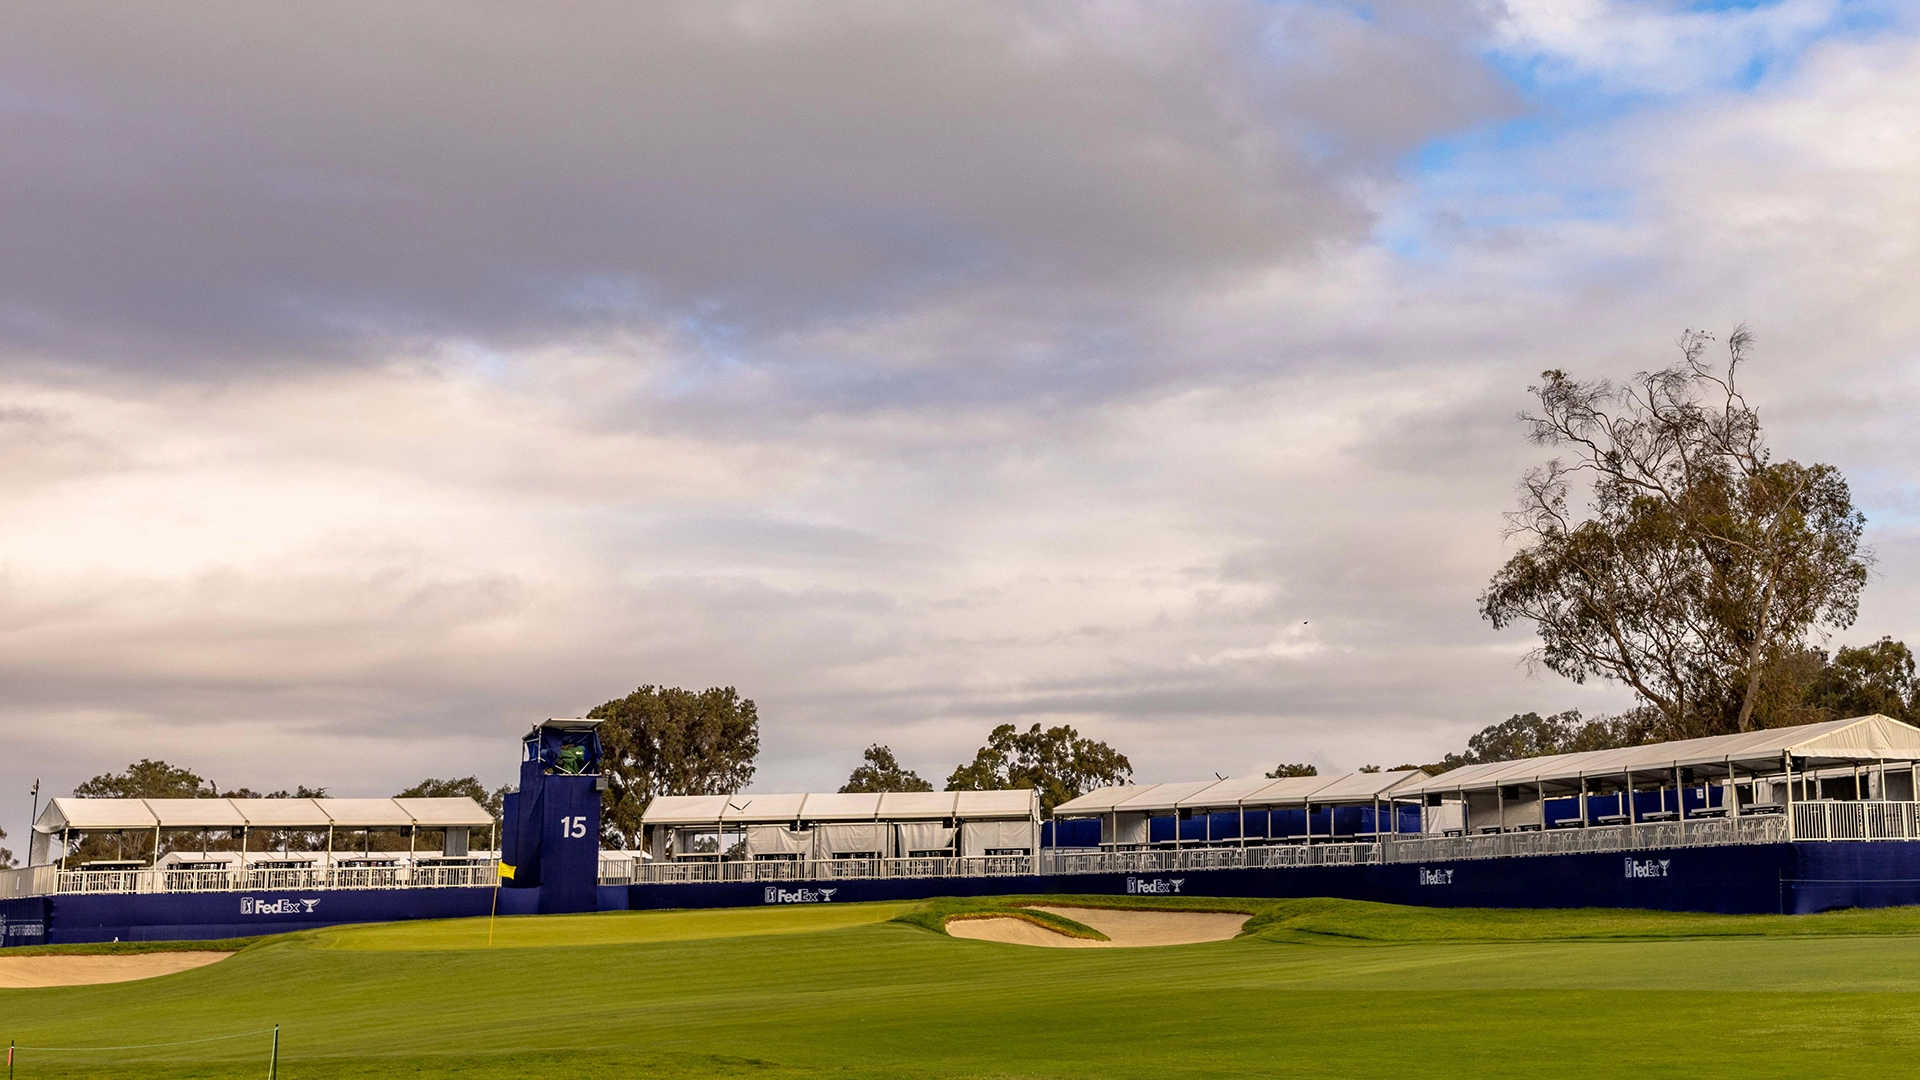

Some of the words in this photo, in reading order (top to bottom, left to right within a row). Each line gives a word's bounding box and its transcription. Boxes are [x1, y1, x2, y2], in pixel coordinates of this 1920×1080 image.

[561, 816, 587, 838] 15
[1633, 860, 1660, 878] FedEx
[1426, 869, 1446, 885] FedEx
[1137, 879, 1170, 893] FedEx
[777, 888, 819, 903] FedEx
[255, 899, 301, 914] FedEx
